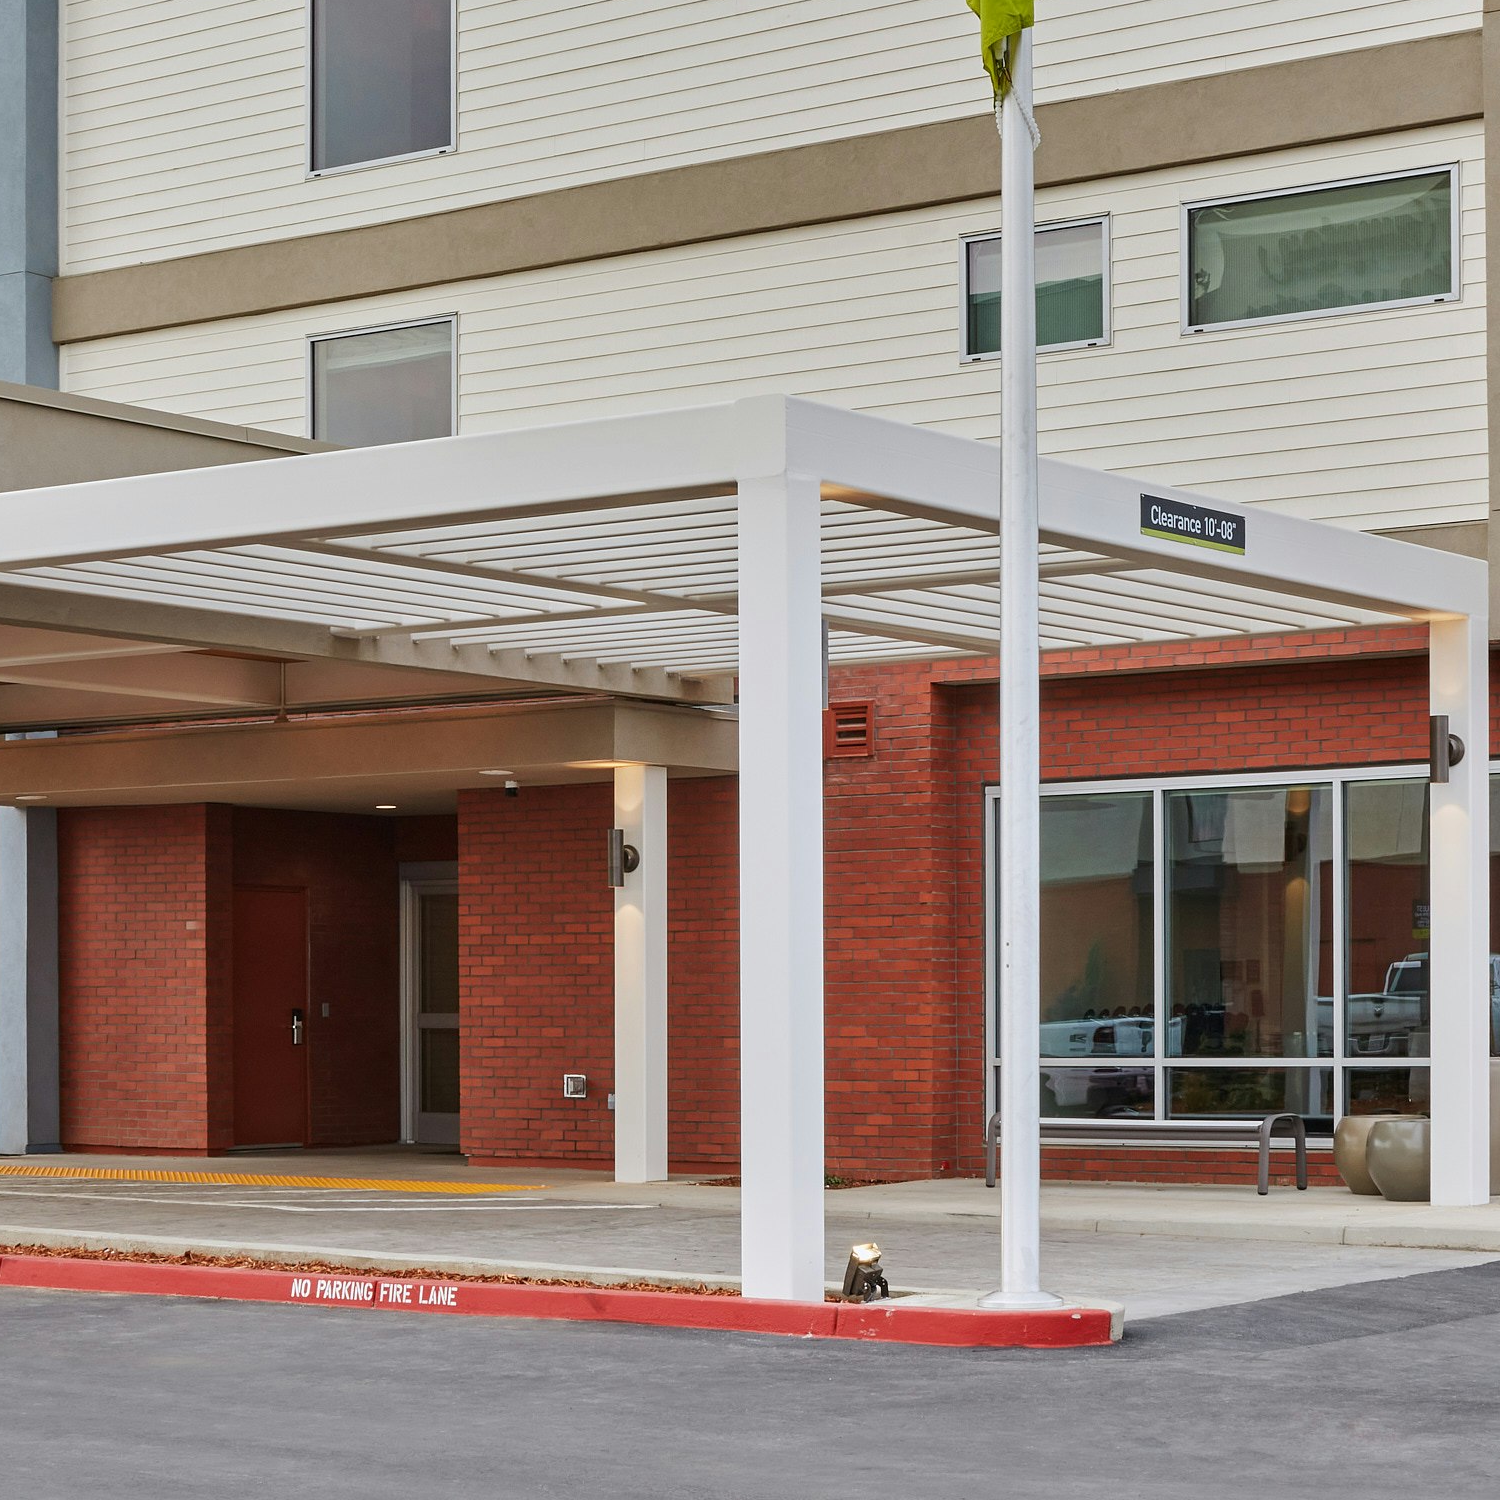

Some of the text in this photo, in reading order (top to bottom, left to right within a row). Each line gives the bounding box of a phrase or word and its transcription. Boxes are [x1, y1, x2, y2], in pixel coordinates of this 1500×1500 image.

[1150, 504, 1237, 541] Clearance 10'-08"
[291, 1278, 458, 1306] NO PARKING FIRE LANE
